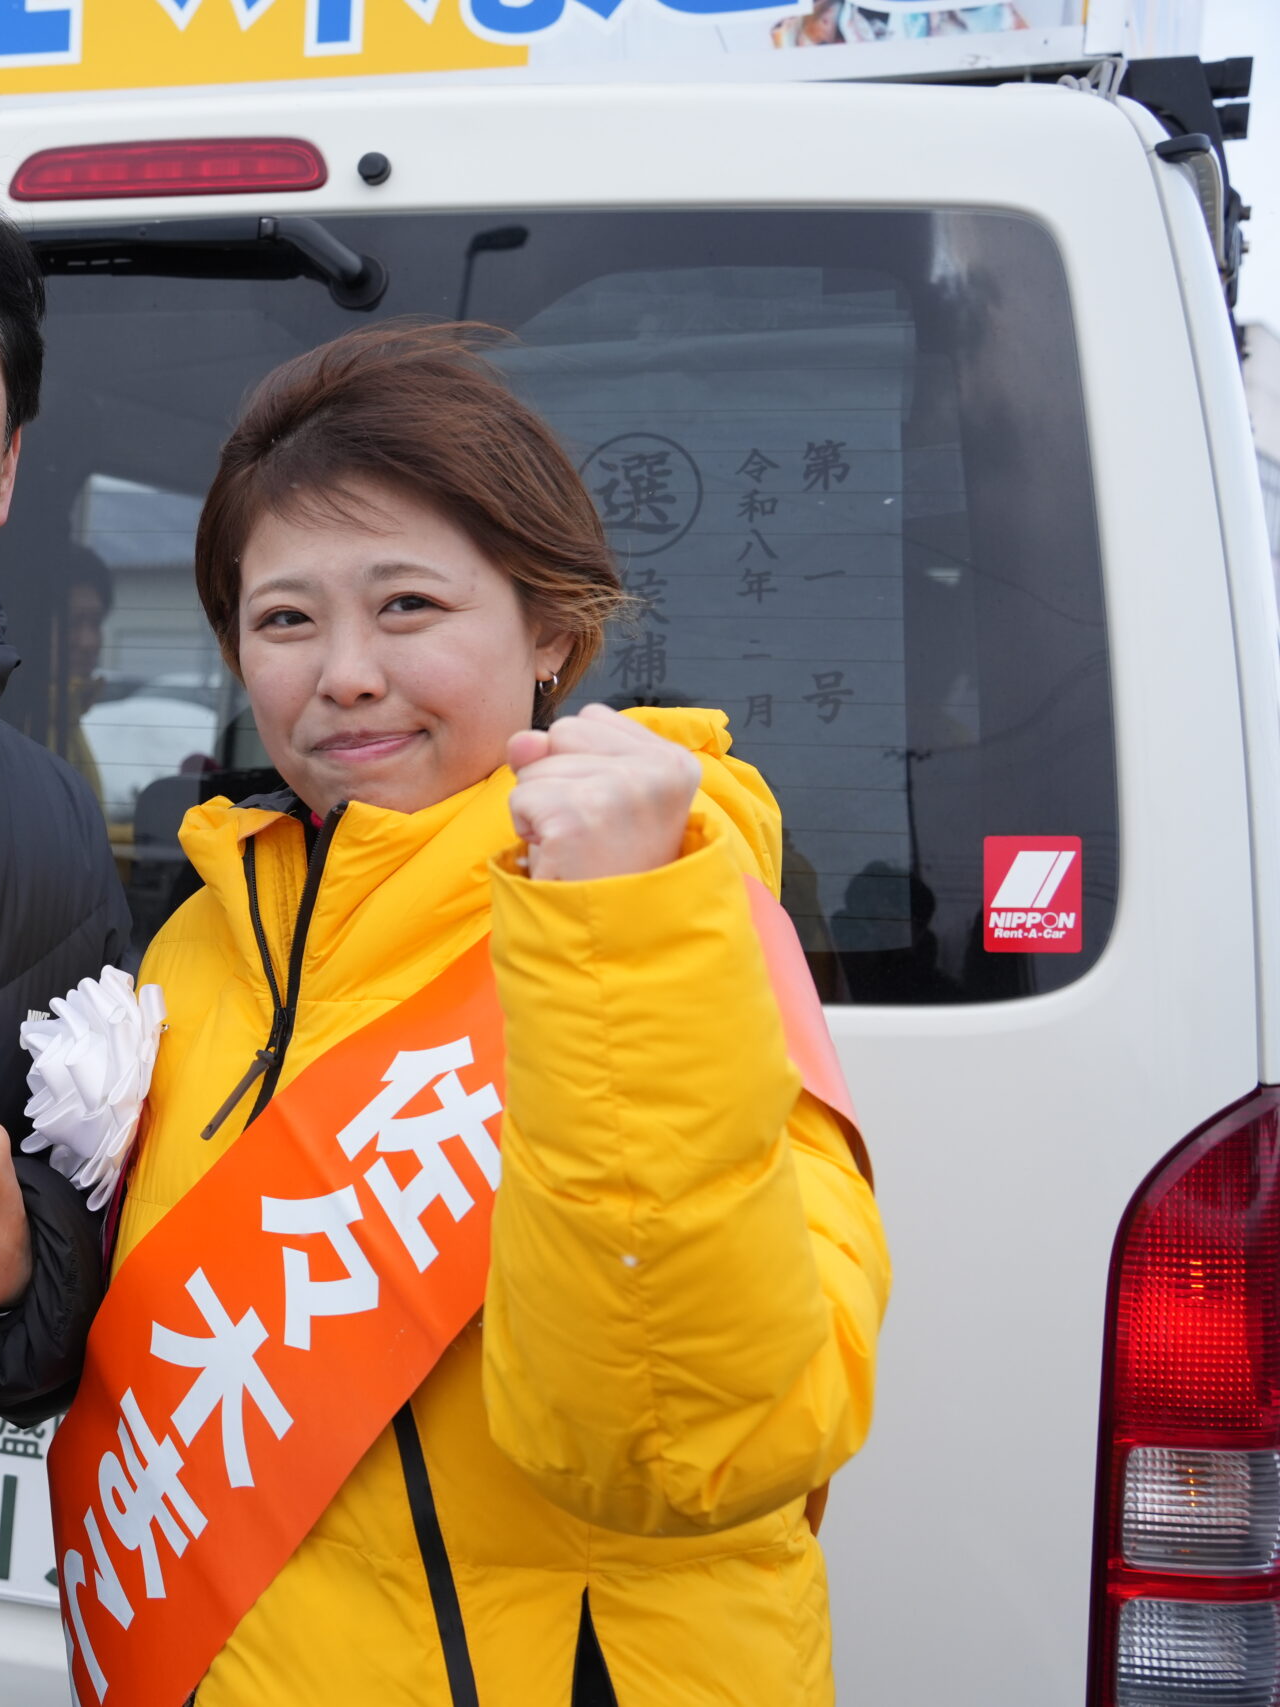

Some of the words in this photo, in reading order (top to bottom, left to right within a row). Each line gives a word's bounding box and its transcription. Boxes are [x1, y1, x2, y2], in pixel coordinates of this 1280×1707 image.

[591, 450, 682, 537] 選
[609, 567, 672, 706] 候補
[734, 447, 780, 729] 令和八年二月
[801, 439, 855, 725] 第一号
[988, 911, 1076, 929] NIPPON
[993, 928, 1067, 939] Rent-A-Car
[64, 1035, 504, 1707] 佐々木まこ
